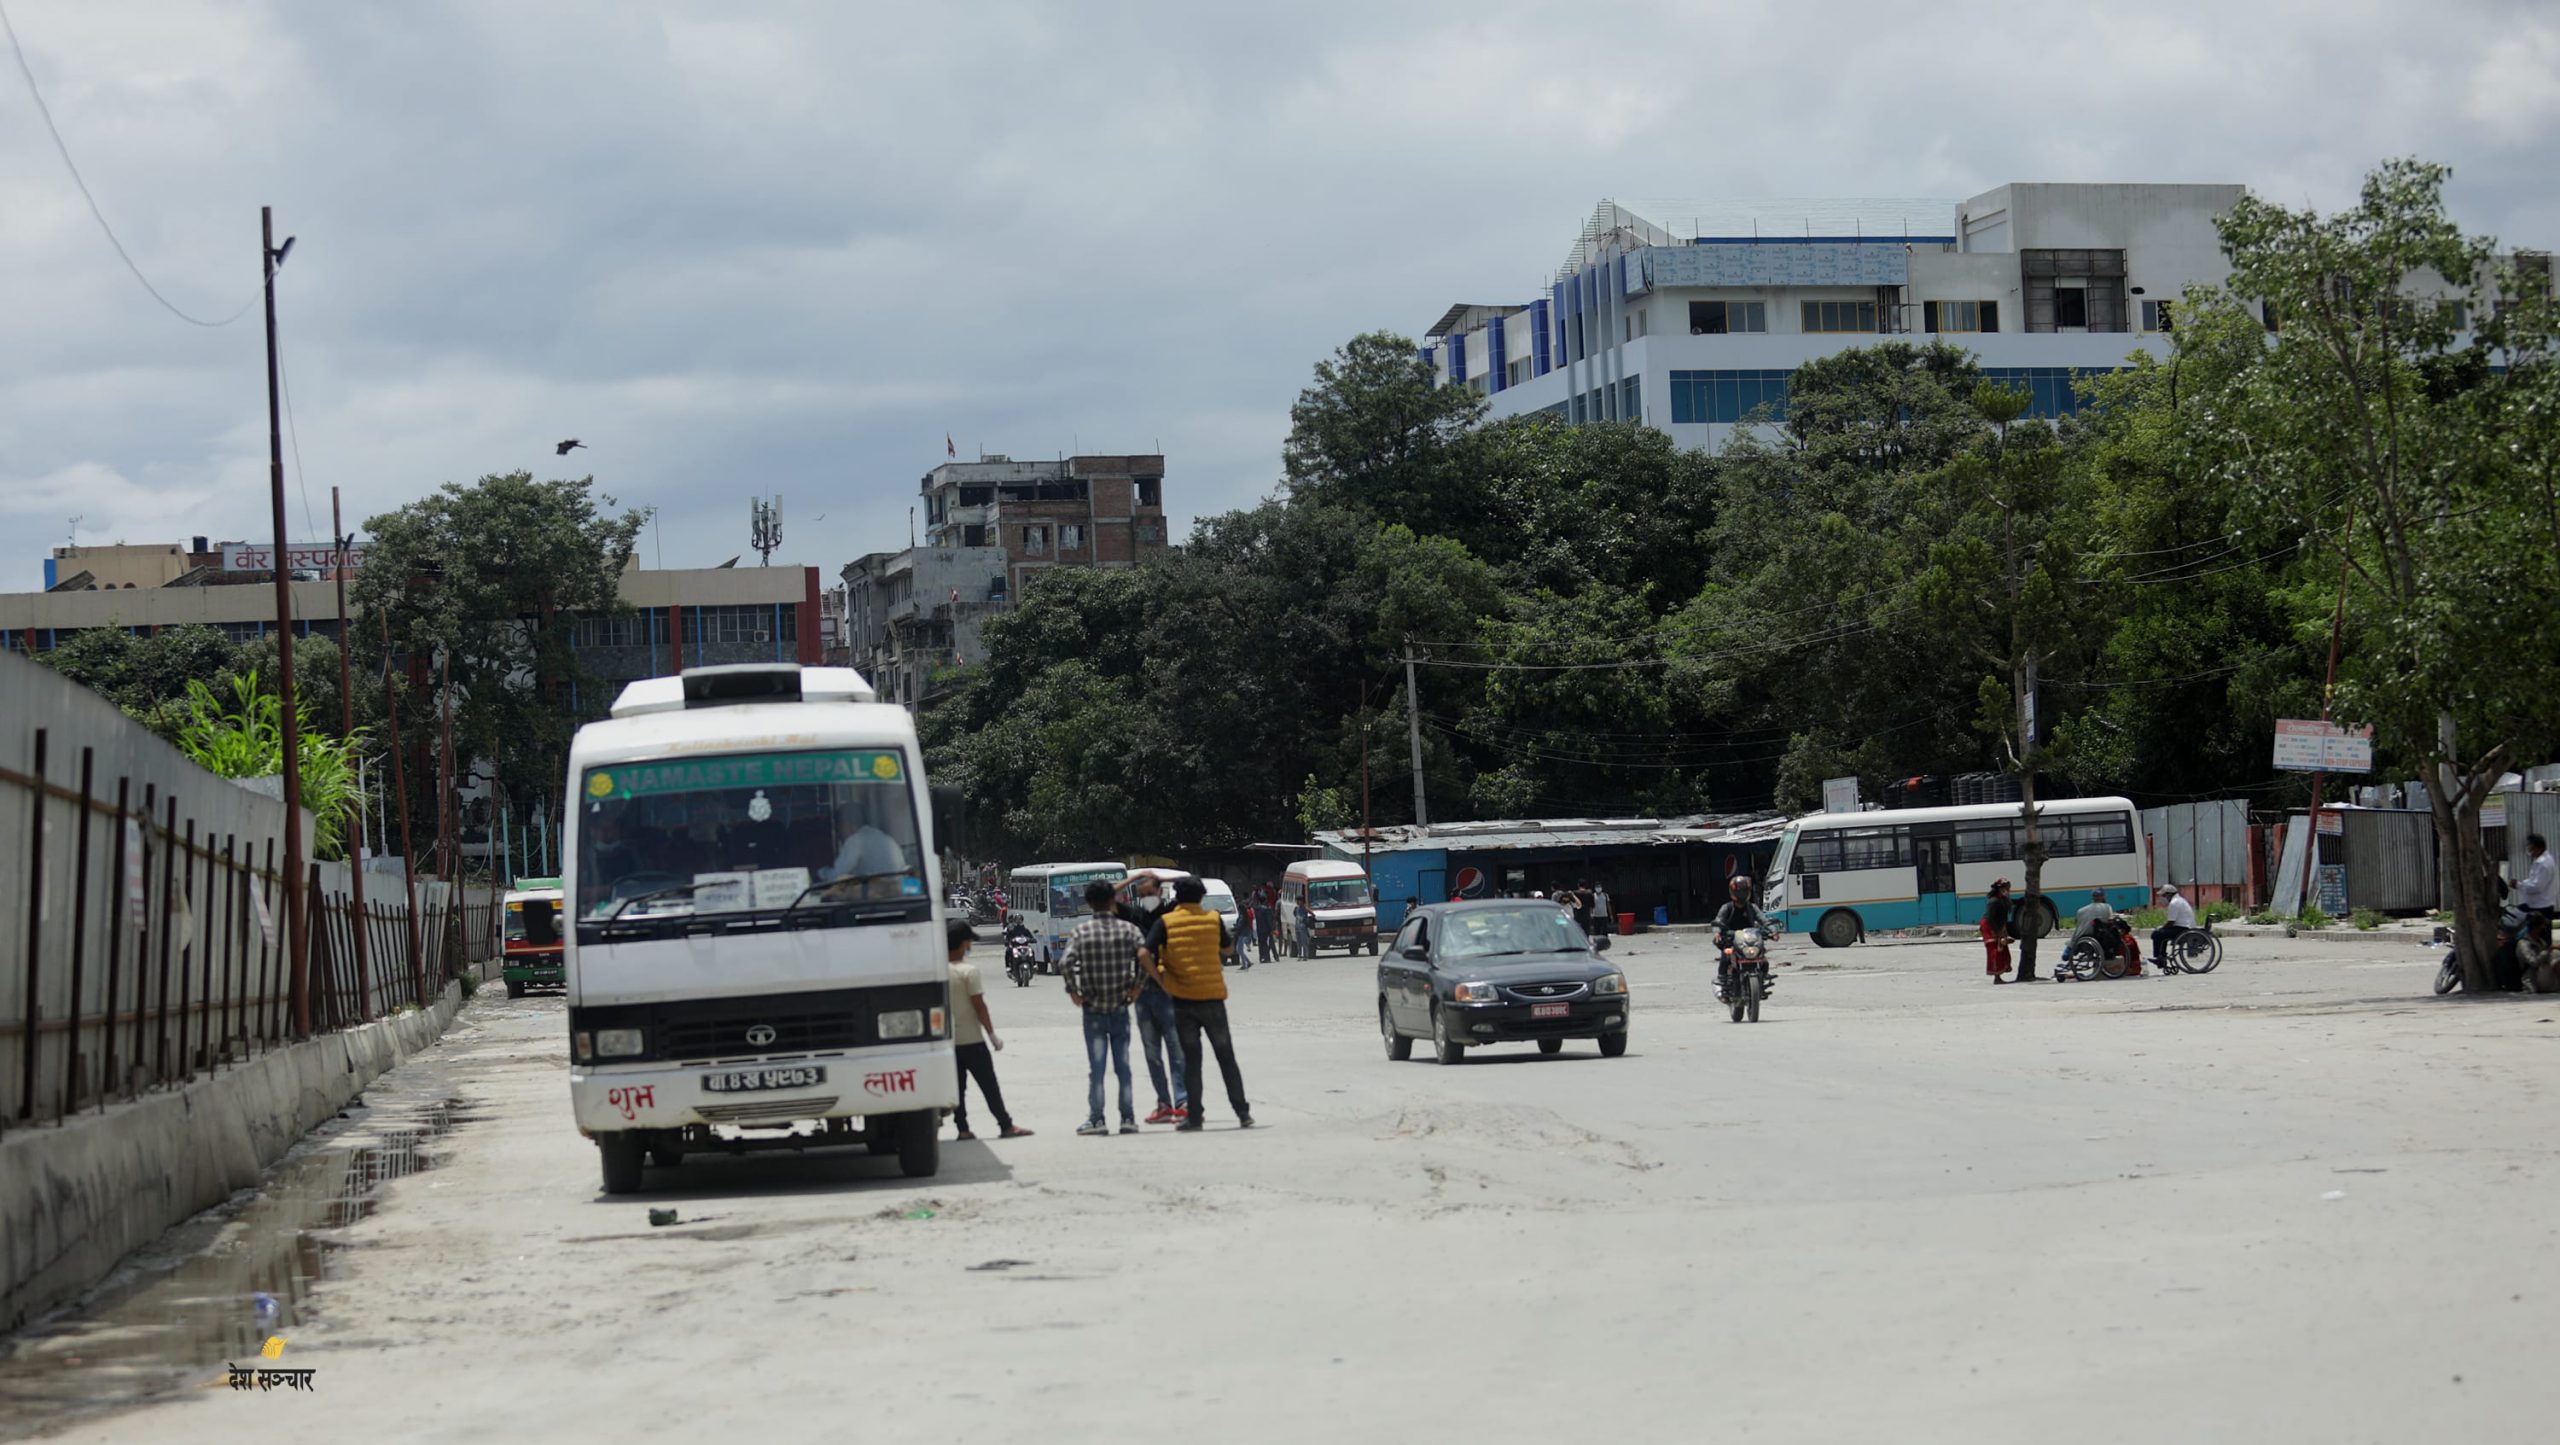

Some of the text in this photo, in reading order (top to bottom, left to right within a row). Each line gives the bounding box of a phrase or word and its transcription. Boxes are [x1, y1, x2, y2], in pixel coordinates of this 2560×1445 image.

[235, 546, 271, 569] वीर
[619, 756, 870, 791] NAMASTE NEPAL
[863, 1069, 917, 1097] लाभ
[608, 1084, 655, 1120] शुभ
